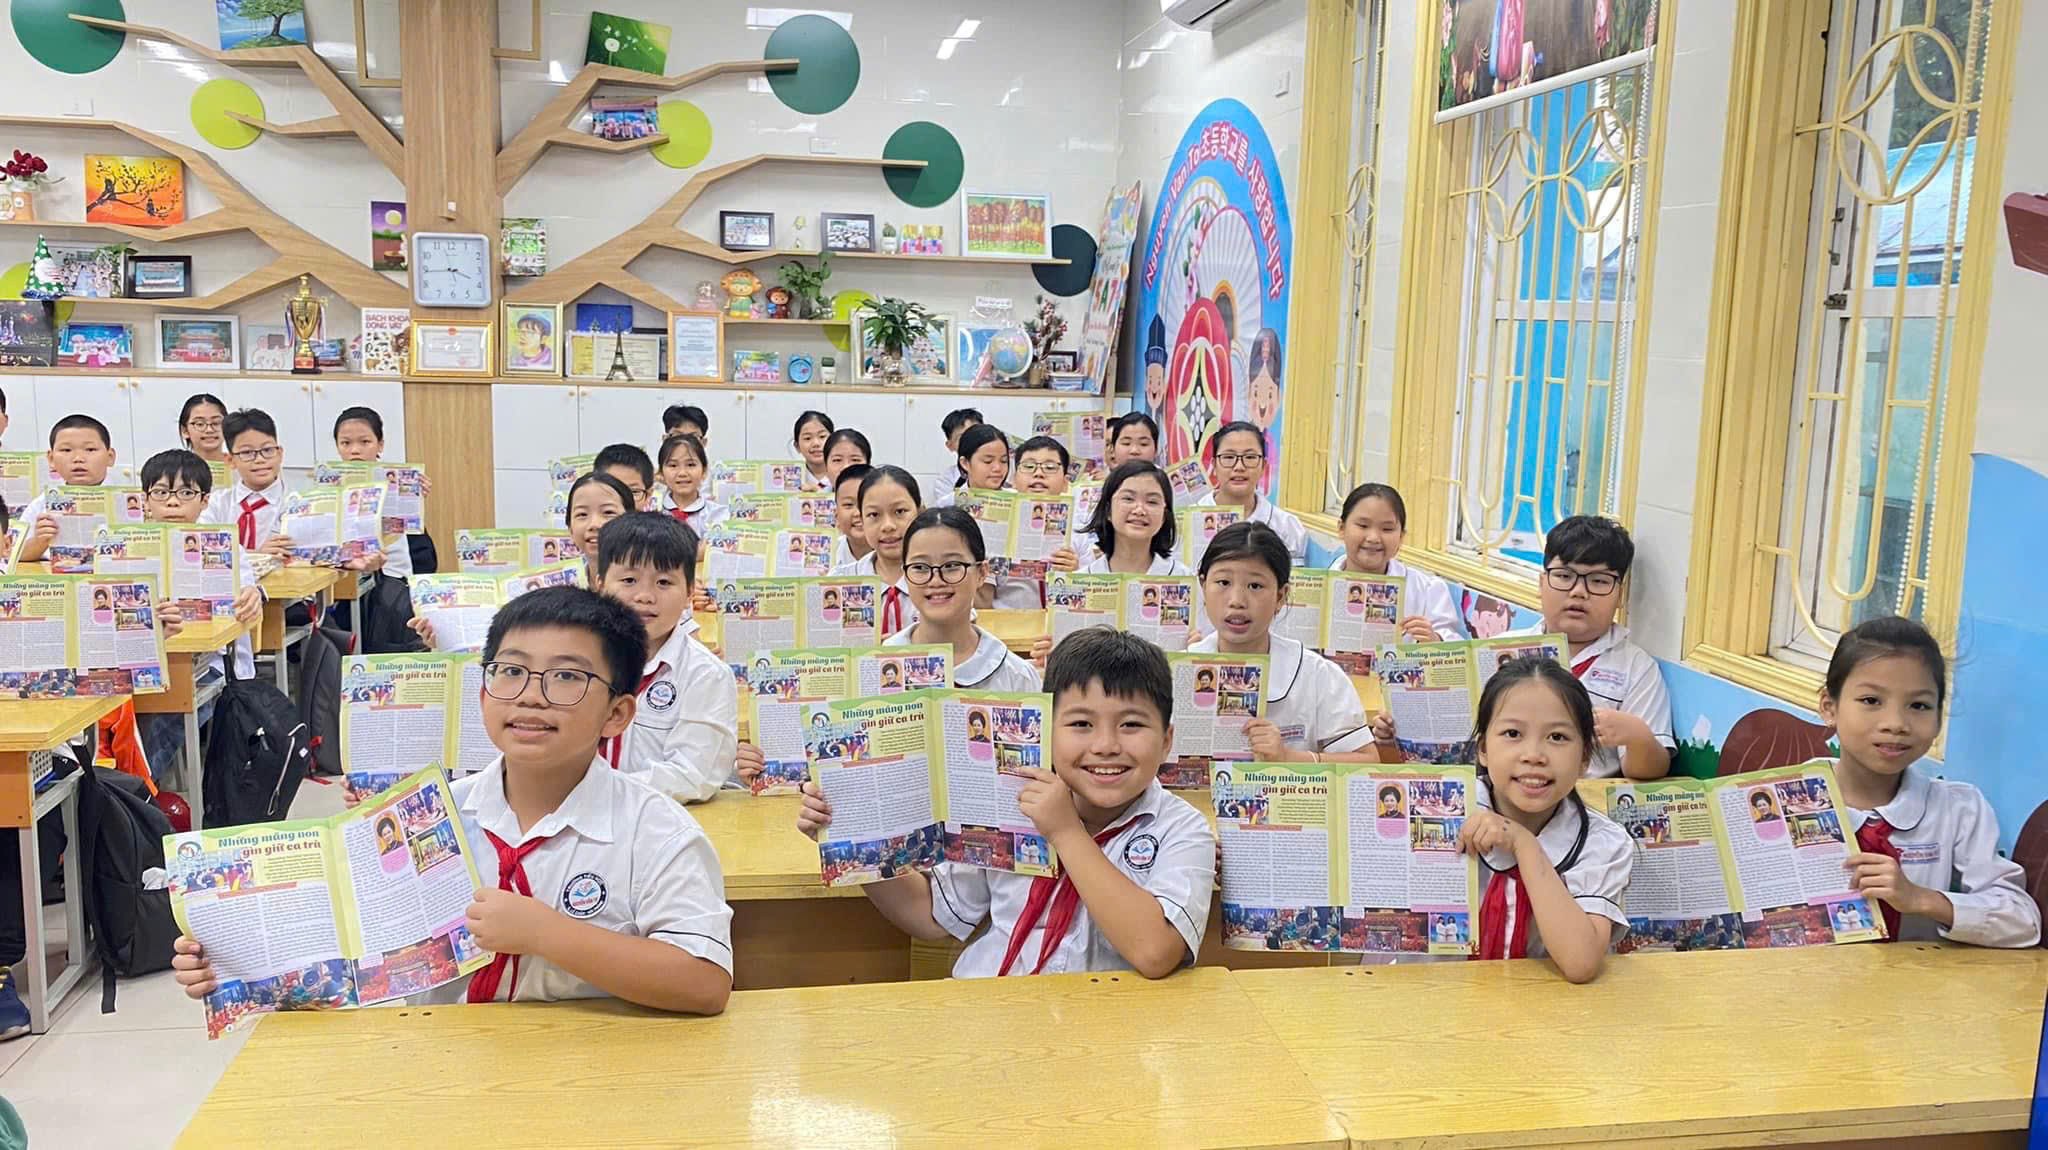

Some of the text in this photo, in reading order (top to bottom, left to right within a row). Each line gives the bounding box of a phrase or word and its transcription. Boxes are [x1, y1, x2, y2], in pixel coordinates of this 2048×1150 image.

[1170, 165, 1188, 200] Van
[1188, 145, 1200, 169] To
[1200, 124, 1249, 174] 초등학교를
[1247, 158, 1283, 298] 사랑합니다
[1244, 772, 1277, 784] Những
[1279, 774, 1307, 784] măng
[1262, 784, 1278, 795] gìn
[1280, 785, 1297, 796] giữ
[1312, 785, 1328, 794] trù
[218, 830, 319, 848] Những măng non
[242, 847, 262, 858] gìn
[265, 843, 285, 855] giữ
[303, 840, 321, 849] trù
